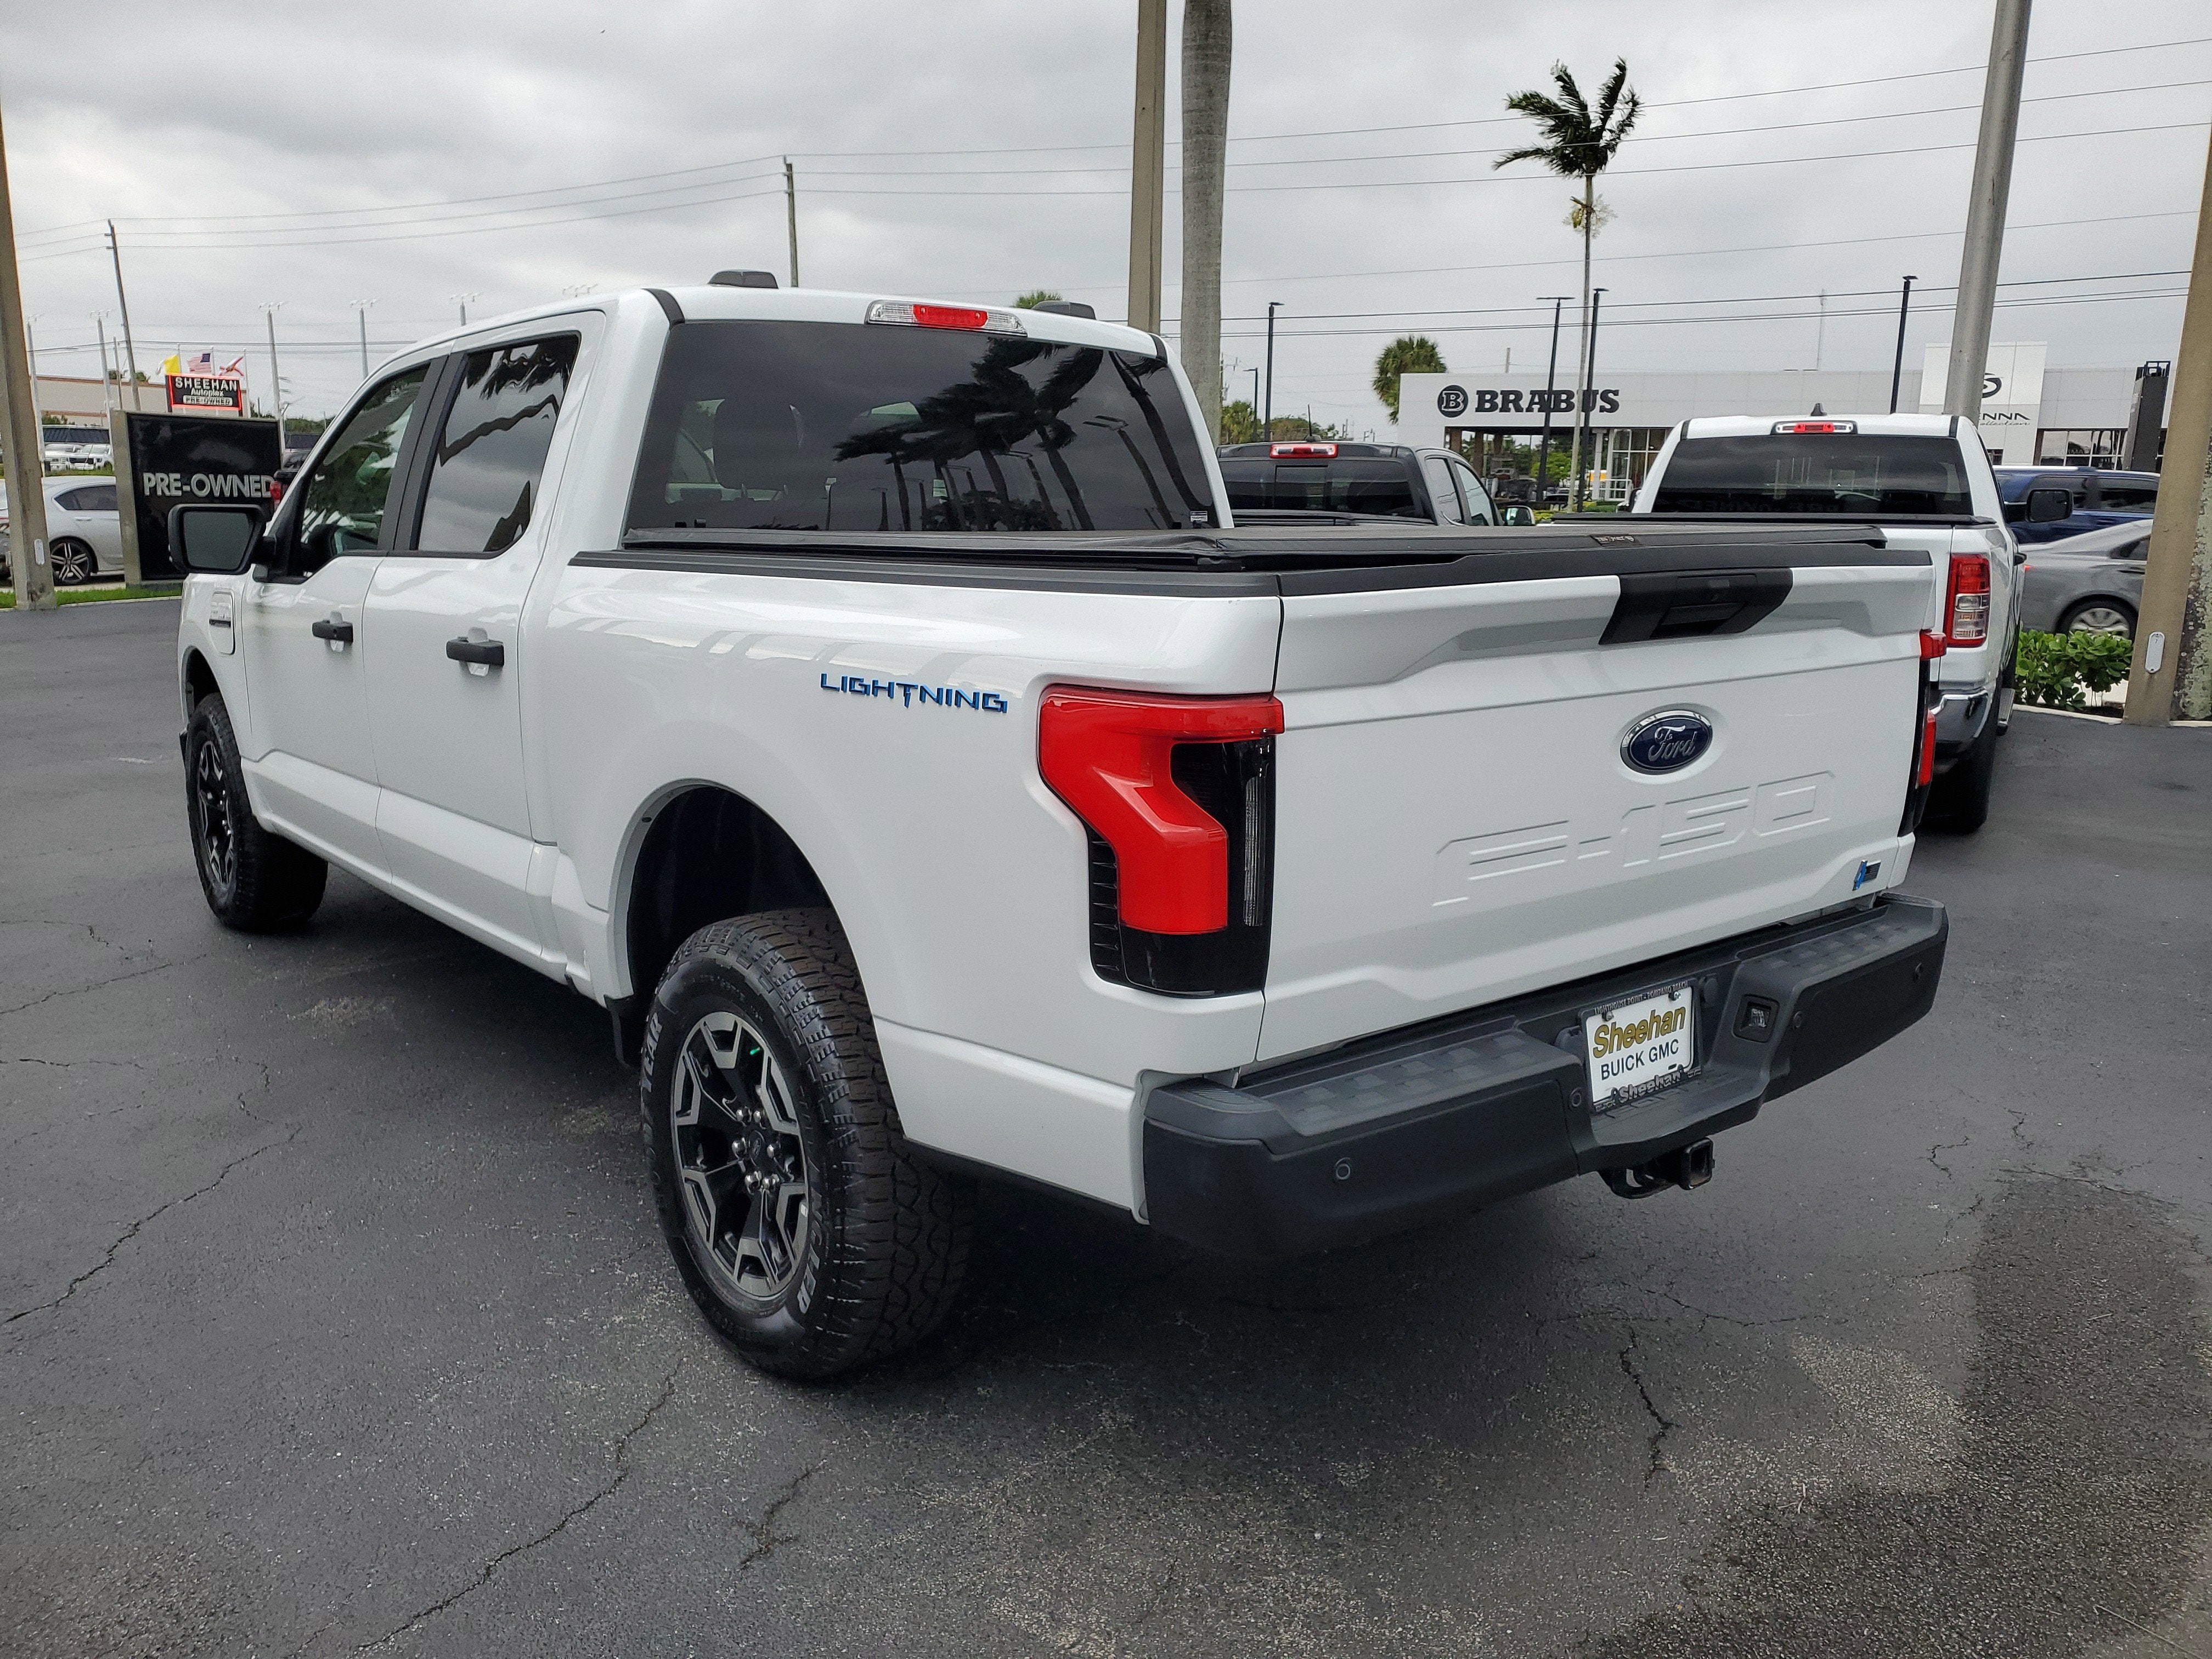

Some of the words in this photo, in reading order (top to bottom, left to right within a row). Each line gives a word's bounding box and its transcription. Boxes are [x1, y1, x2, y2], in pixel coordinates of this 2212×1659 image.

[175, 376, 237, 391] SHEEHAN
[191, 387, 224, 397] Autoplex
[1475, 389, 1620, 413] BRABUS
[143, 472, 275, 498] PRE-OWNED
[820, 673, 1008, 713] LIGHTNING
[1647, 725, 1698, 762] Ford
[1431, 770, 1835, 906] F-150
[1594, 998, 1627, 1015] LIGHTHOUSE
[1627, 994, 1644, 1006] POINT
[1647, 986, 1672, 998] POMPANO
[1672, 980, 1689, 991] BEACH
[1593, 1006, 1686, 1059] Sheehan
[1600, 1050, 1645, 1081] BUICK
[1648, 1039, 1679, 1063] GMC
[1618, 1073, 1681, 1103] Sheehan
